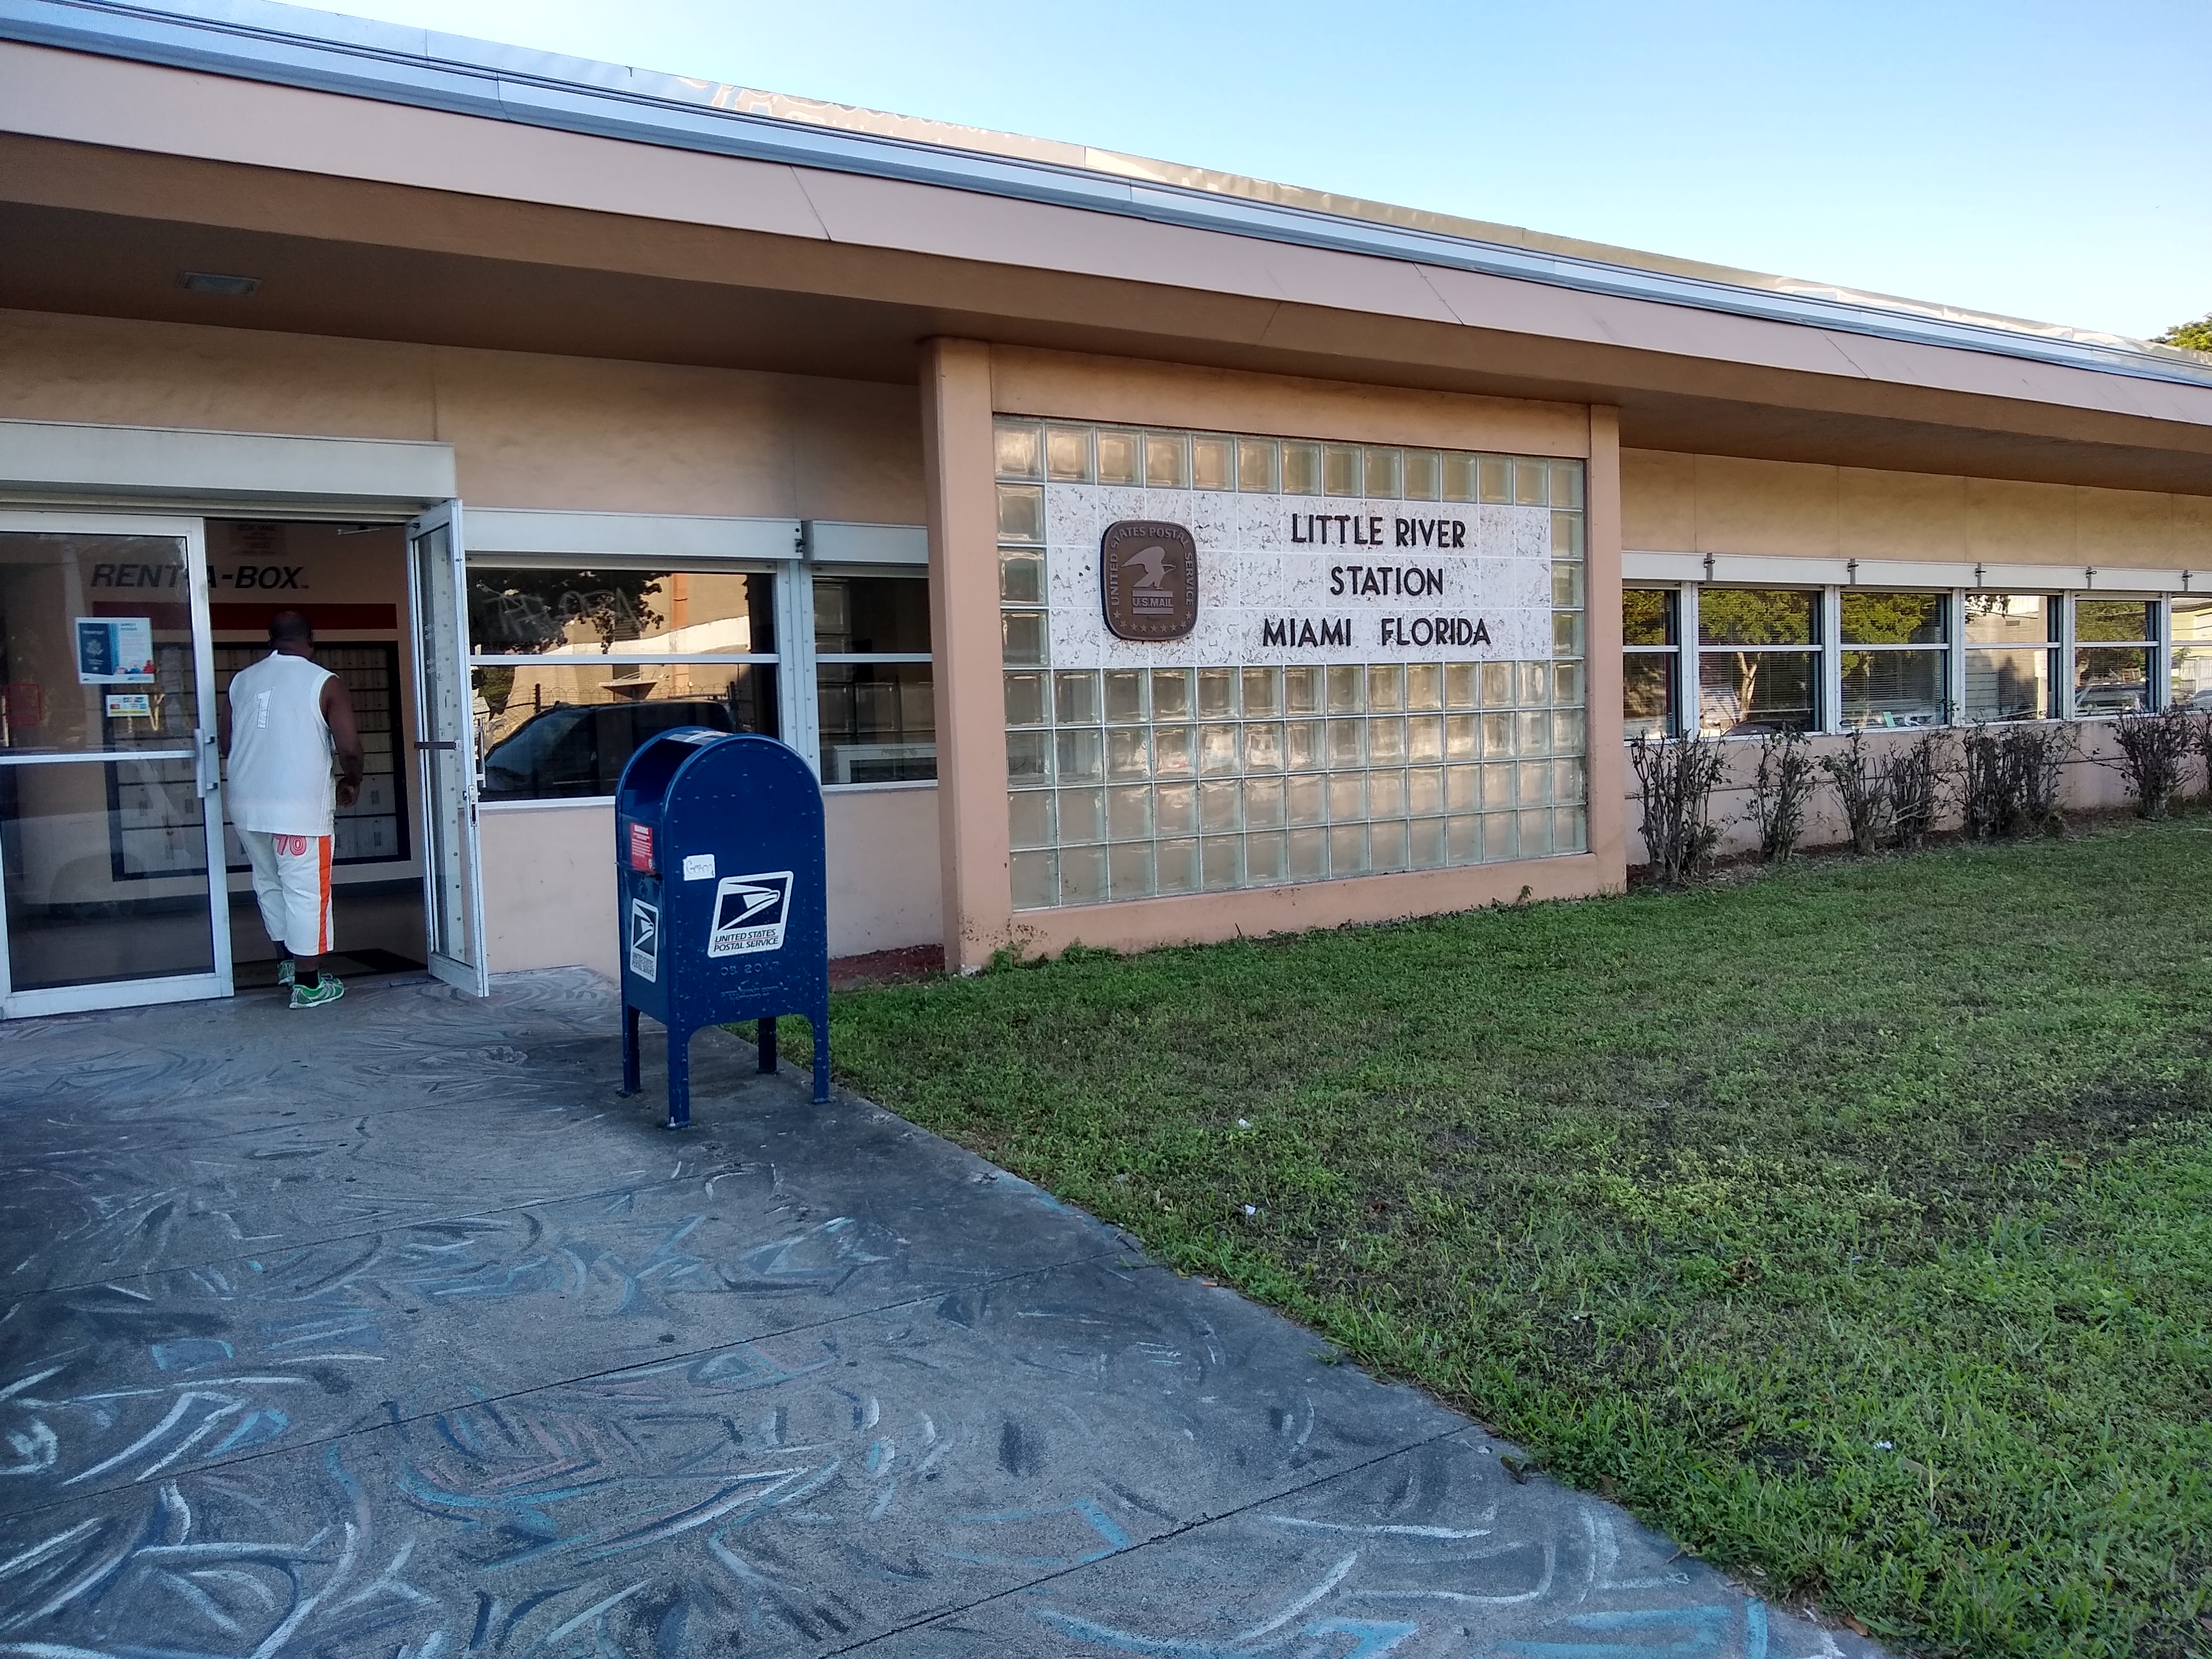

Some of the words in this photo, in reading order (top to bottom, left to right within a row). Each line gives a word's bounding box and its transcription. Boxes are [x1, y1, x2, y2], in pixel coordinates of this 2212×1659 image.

[1111, 527, 1146, 550] STATES
[1149, 527, 1189, 549] POSTAL
[1291, 513, 1383, 545] LITTLE
[1395, 518, 1466, 548] RIVER
[90, 563, 303, 590] RENT-BOX
[1110, 554, 1119, 606] UNITED
[1184, 552, 1195, 606] SERVICE
[1330, 566, 1443, 595] STATION
[1263, 618, 1351, 647] MIAMI
[1381, 617, 1491, 646] FLORIDA
[255, 687, 274, 730] 1
[714, 942, 744, 952] POSTAL
[746, 937, 779, 948] SERVICE
[715, 932, 746, 943] UNITED
[748, 928, 776, 939] STATES
